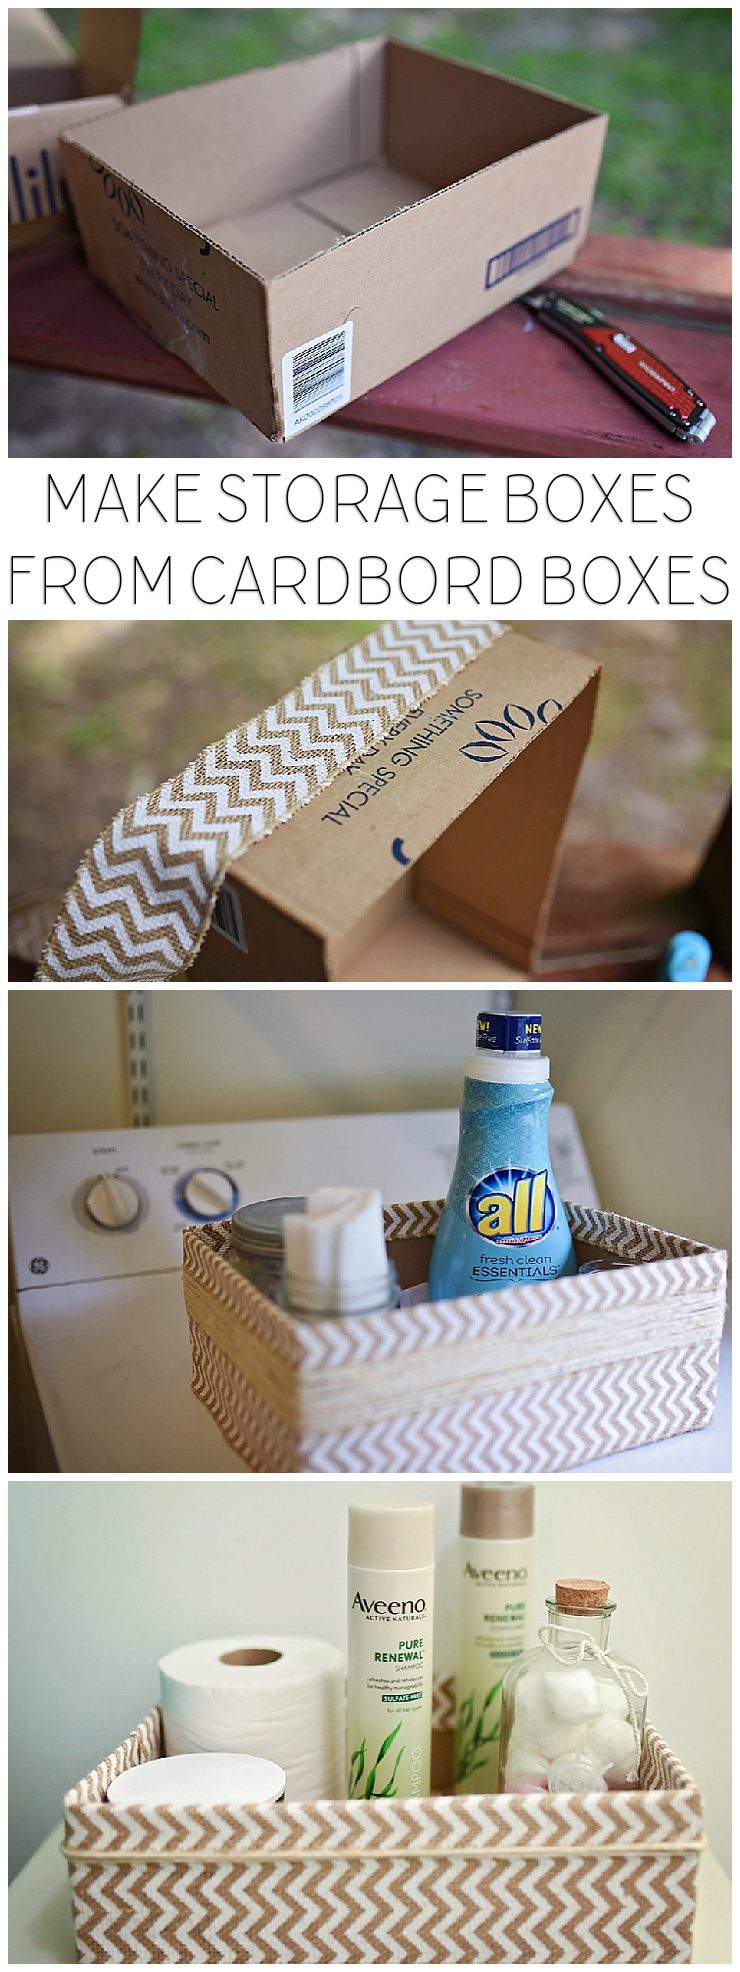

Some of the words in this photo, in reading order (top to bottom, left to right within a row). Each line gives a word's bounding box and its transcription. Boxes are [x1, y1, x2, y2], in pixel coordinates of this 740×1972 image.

[391, 688, 483, 766] SOMETHING
[321, 766, 396, 825] SPECIAL
[476, 1169, 549, 1238] all
[479, 1253, 514, 1265] fresh
[516, 1254, 552, 1265] clean
[472, 1265, 559, 1277] ESSENTIALS
[464, 1562, 528, 1581] Aveeno
[351, 1590, 426, 1615] Aveeno
[398, 1638, 424, 1650] PURE
[373, 1650, 424, 1663] RENEWAL
[394, 1661, 424, 1673] SHAMPOO
[410, 1747, 422, 1797] MPOO
